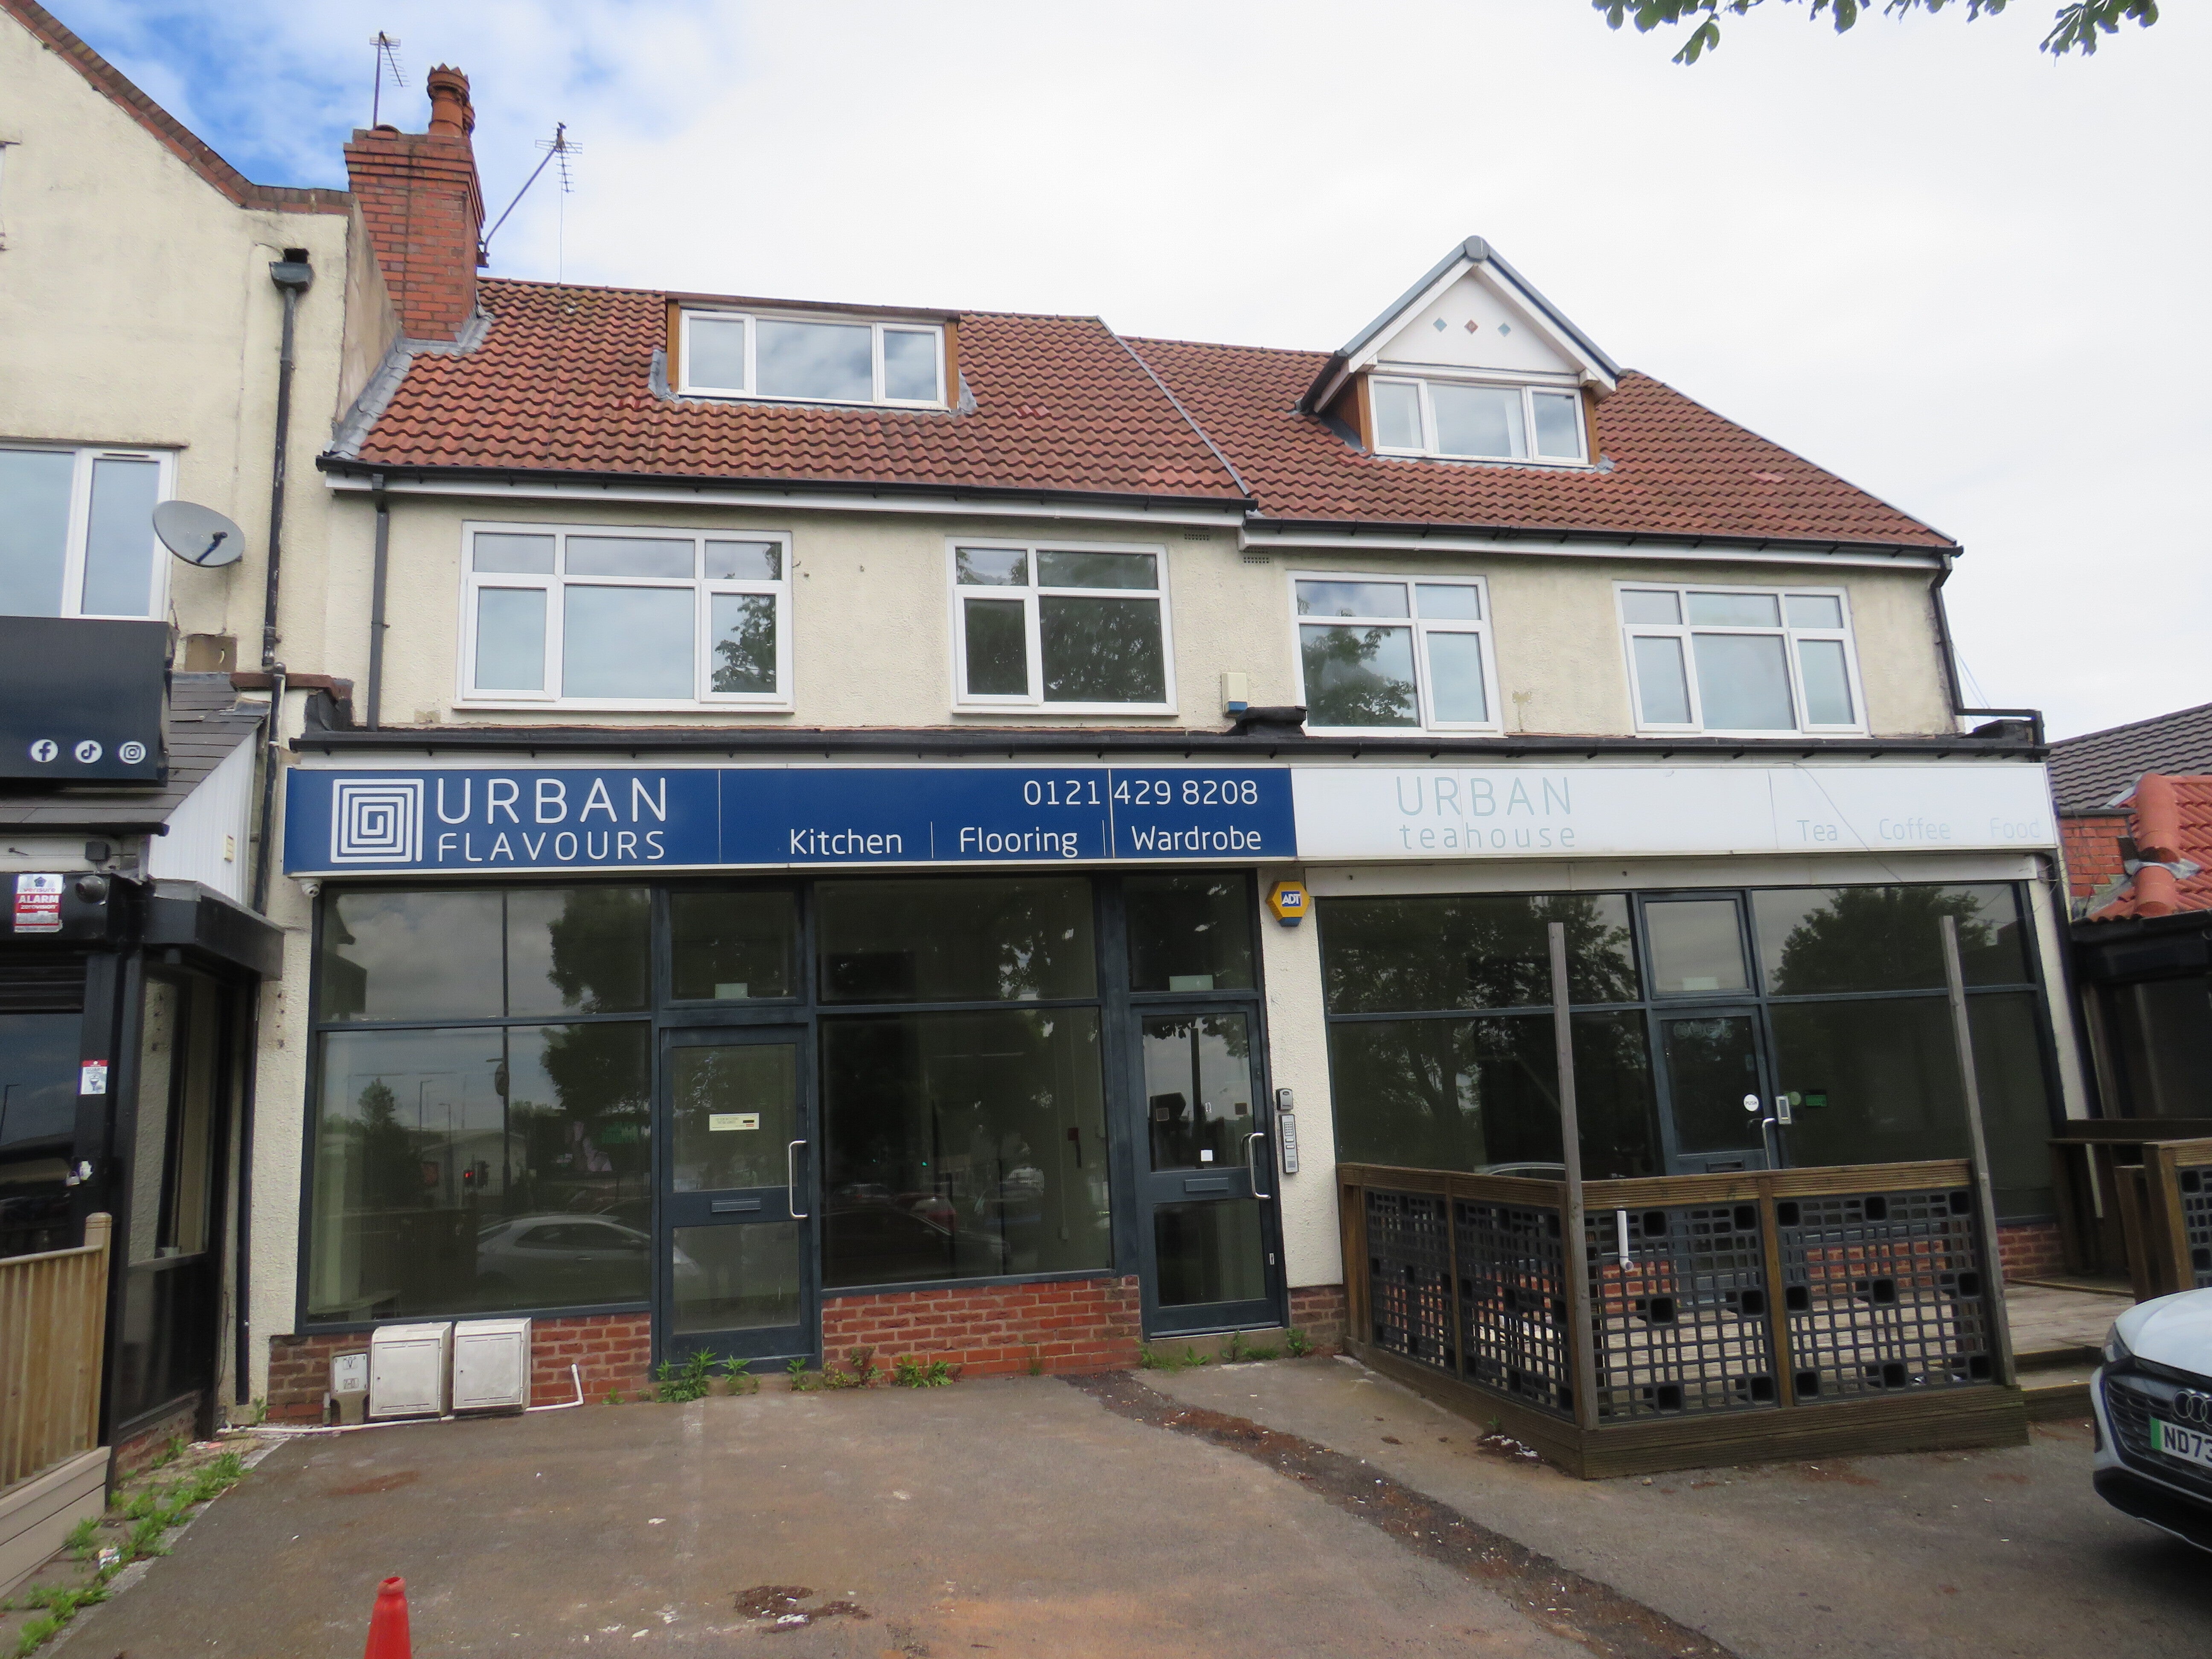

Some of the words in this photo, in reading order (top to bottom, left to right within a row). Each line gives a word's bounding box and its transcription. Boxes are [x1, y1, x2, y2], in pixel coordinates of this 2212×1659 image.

[437, 777, 667, 824] URBAN
[1024, 780, 1100, 805] 0121
[1114, 780, 1171, 804] 429
[1182, 780, 1258, 804] 8208
[1396, 776, 1572, 816] URBAN
[790, 828, 902, 855] Kitchen
[959, 827, 1078, 858] Flooring
[1132, 825, 1261, 850] Wardrobe
[1399, 823, 1576, 850] teahouse
[1797, 819, 1838, 842] Tea
[1879, 818, 1950, 840] Coffee
[1990, 817, 2040, 839] Food
[438, 830, 665, 862] FLAVOURS
[18, 895, 60, 903] ALARM
[1281, 893, 1301, 905] ADT
